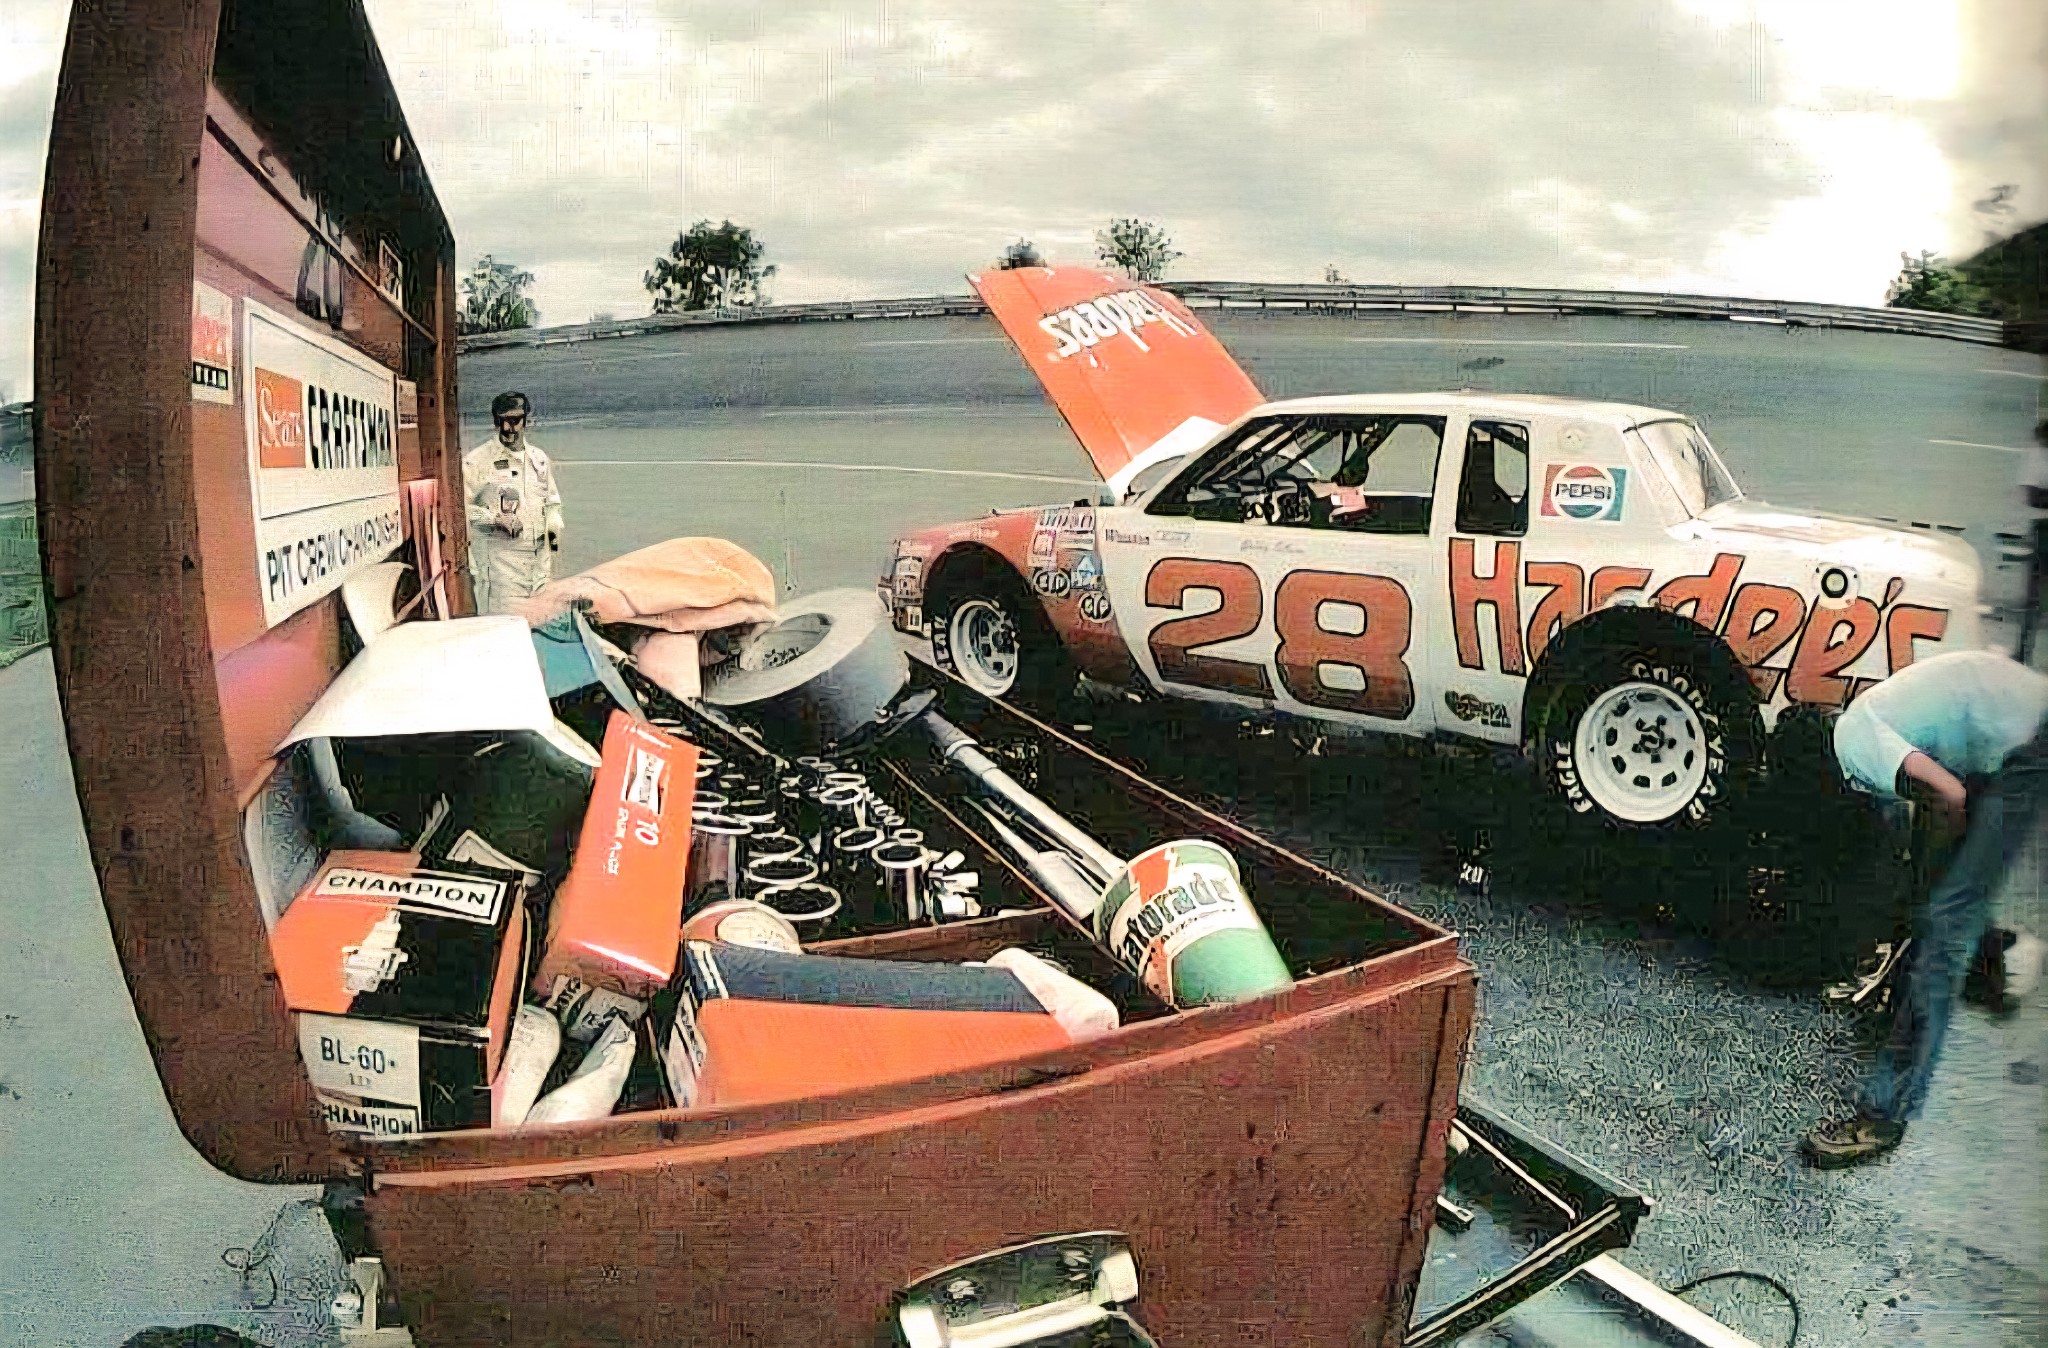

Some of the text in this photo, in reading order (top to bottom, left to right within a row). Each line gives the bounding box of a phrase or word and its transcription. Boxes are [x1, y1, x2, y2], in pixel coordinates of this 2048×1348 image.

[1555, 483, 1612, 500] PEPSI
[266, 544, 294, 602] PIT
[1145, 556, 1416, 721] 28
[634, 818, 661, 847] 10
[328, 873, 487, 906] CHAMPION
